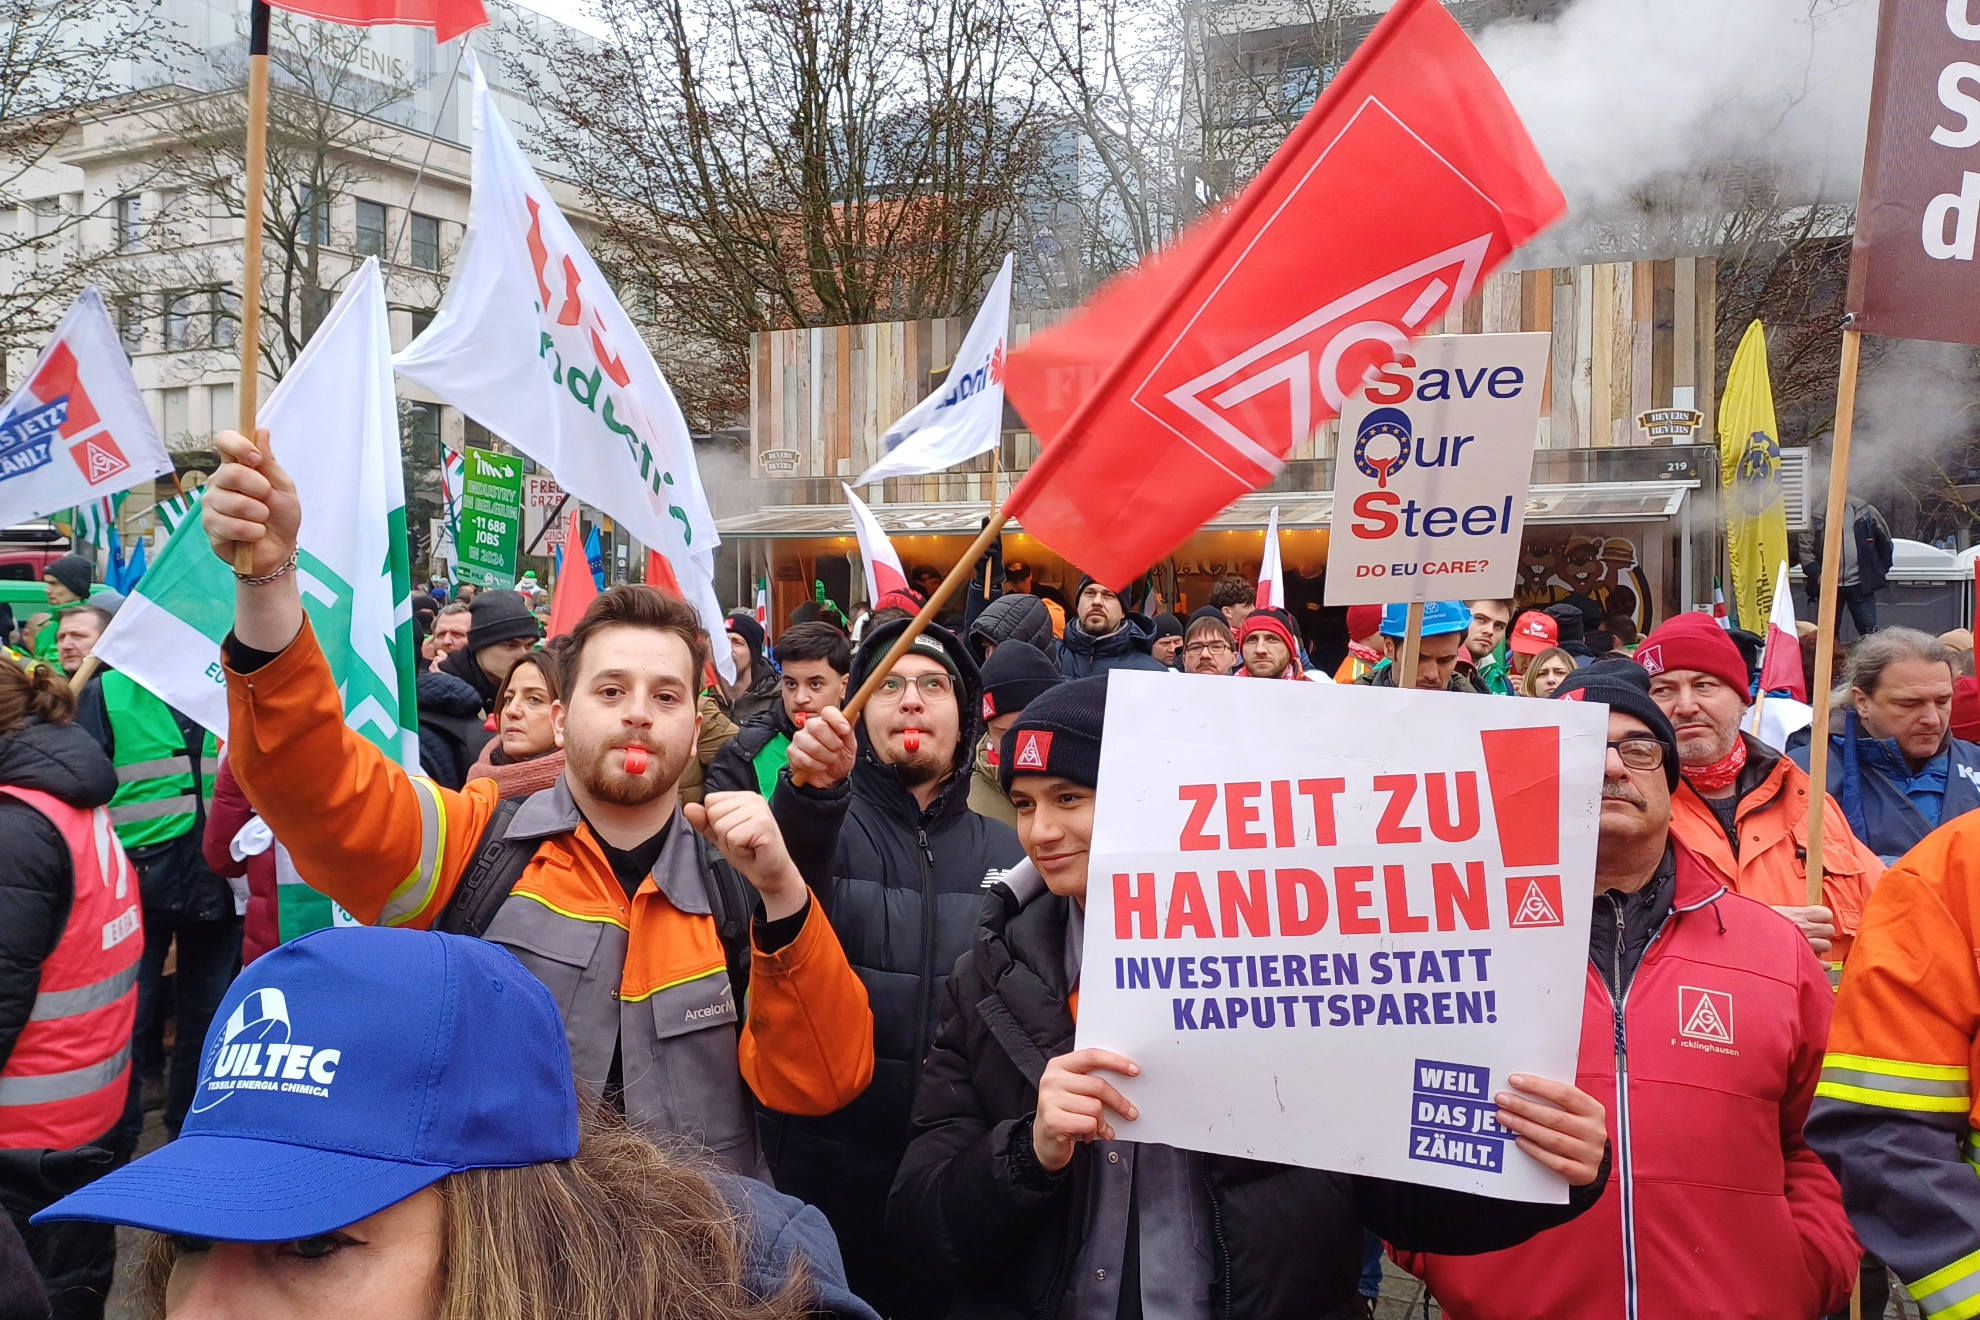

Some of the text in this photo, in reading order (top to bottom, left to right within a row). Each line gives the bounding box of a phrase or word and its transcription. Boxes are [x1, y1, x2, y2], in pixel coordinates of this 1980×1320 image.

[269, 12, 404, 80] ESCHIEDENIS
[1365, 353, 1524, 405] Save
[1651, 412, 1690, 422] BEVERS
[1651, 425, 1690, 435] BEVERS
[1354, 407, 1474, 488] Our
[1667, 462, 1688, 472] 219
[467, 480, 517, 504] INDUSTRY
[530, 495, 564, 507] GAZA
[463, 494, 518, 521] IN BELGIUM
[1351, 491, 1513, 539] Steel
[471, 516, 507, 535] -11 688
[475, 530, 500, 547] JOBS
[469, 546, 505, 567] IN 2024
[1356, 559, 1490, 578] DO EU CARE?
[1178, 776, 1346, 851] ZEIT
[1112, 861, 1491, 939] HANDELN
[1518, 886, 1556, 922] IGM
[1114, 948, 1492, 990] INVESTIEREN STATT
[684, 1000, 734, 1022] ArcelorM
[1172, 990, 1498, 1030] KAPUTTSPAREN!
[1690, 1000, 1725, 1037] IGM
[1671, 1037, 1740, 1057] cklinghausen
[213, 1043, 341, 1085] UILTEC
[208, 1080, 329, 1099] TESSILE ENERGIA CHIMICA
[1420, 1066, 1480, 1095] WEIL
[1418, 1101, 1467, 1128] DAS
[1415, 1132, 1496, 1168] ZÄHLT.
